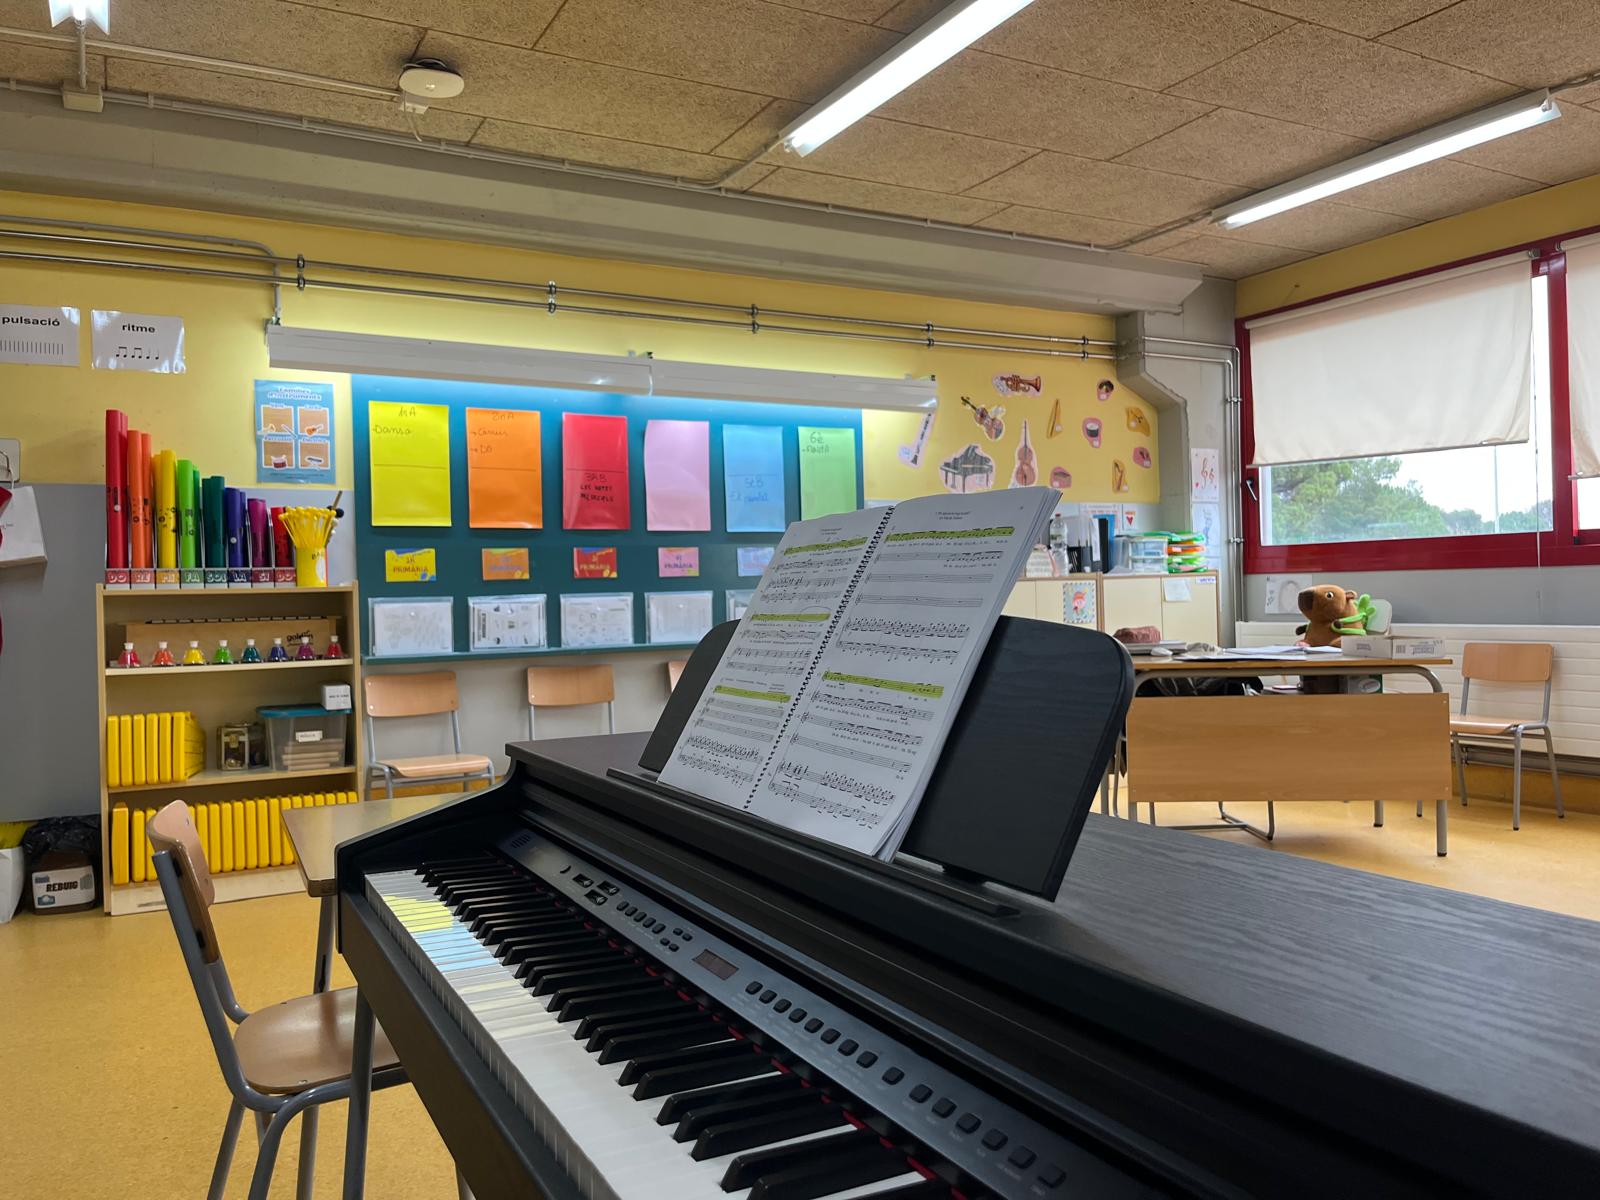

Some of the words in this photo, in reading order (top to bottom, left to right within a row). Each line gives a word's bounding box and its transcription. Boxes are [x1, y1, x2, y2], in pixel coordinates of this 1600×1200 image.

[1, 315, 60, 328] pulsació
[121, 323, 155, 334] ritme
[108, 573, 127, 583] DO
[135, 572, 151, 583] RE
[184, 572, 201, 583] FA
[207, 572, 227, 583] SOL
[234, 572, 247, 582] LA
[46, 881, 78, 892] REBUIG
